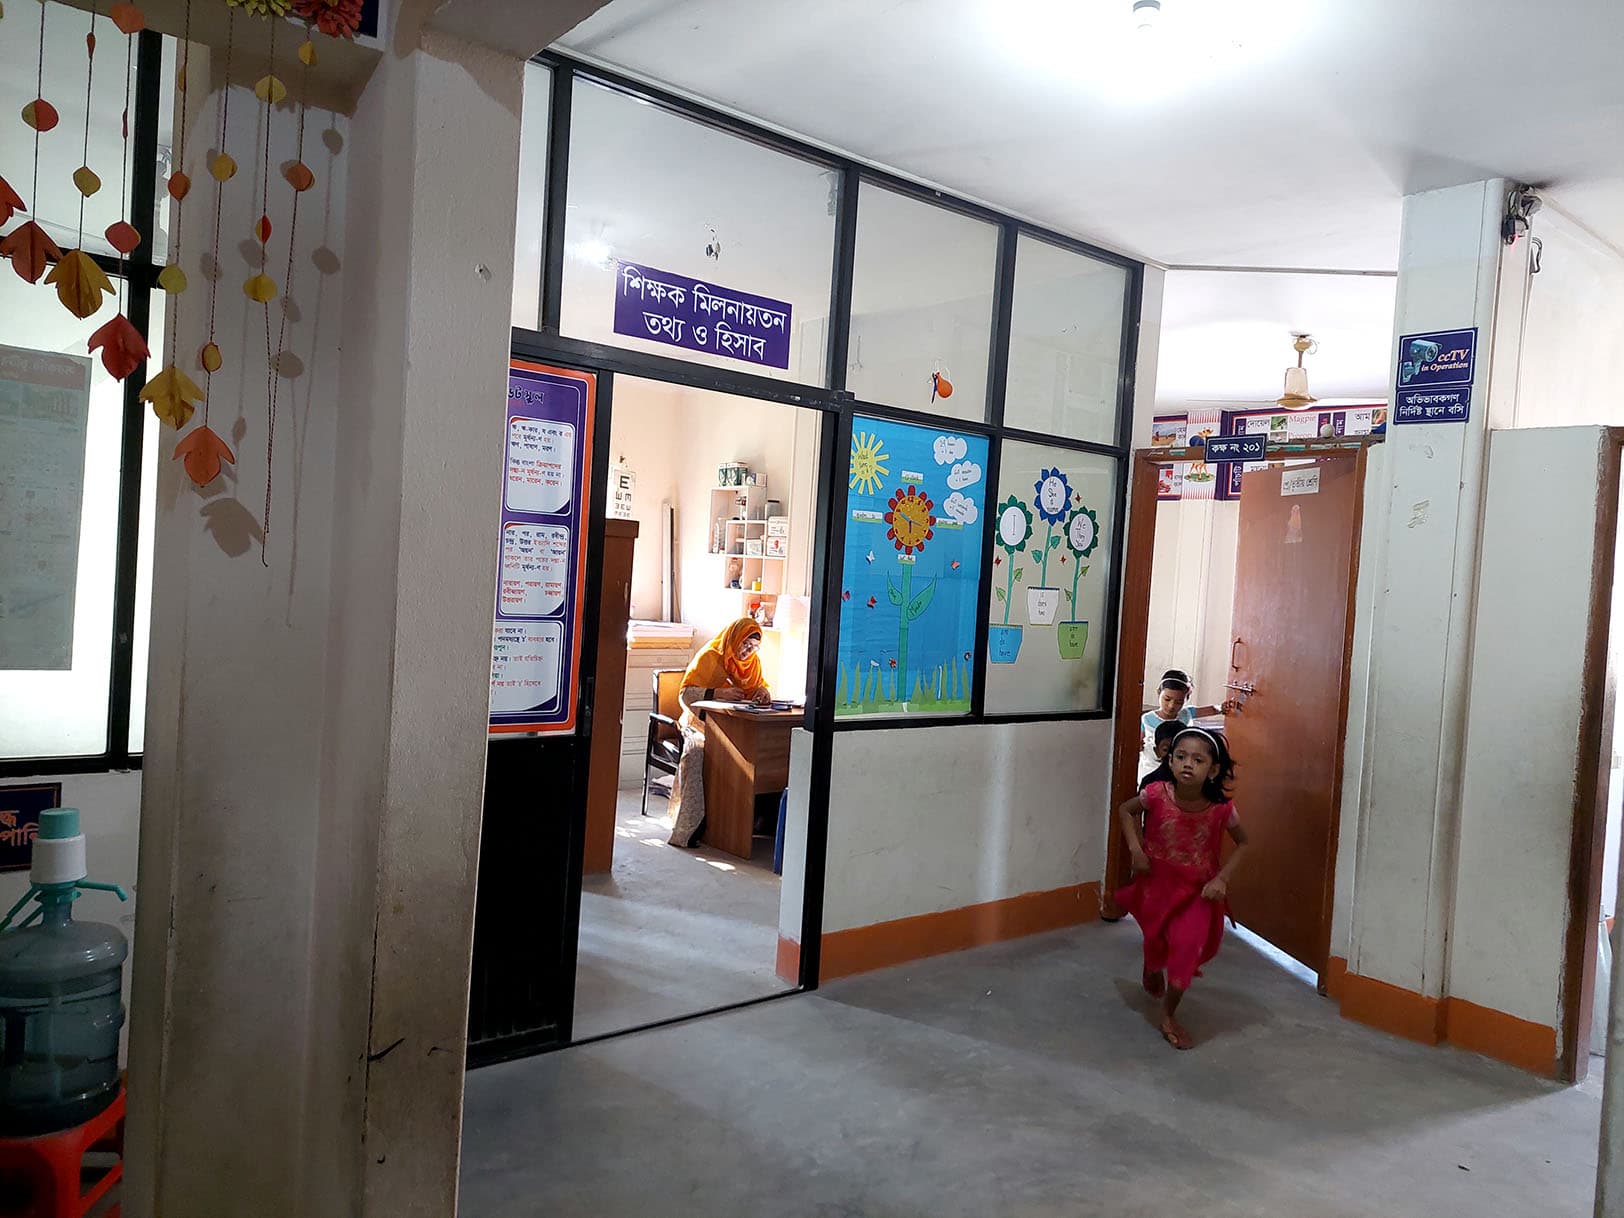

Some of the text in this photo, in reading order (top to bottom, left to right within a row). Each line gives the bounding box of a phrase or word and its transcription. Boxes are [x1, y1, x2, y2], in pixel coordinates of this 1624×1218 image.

[622, 265, 788, 334] শিক্ষক মিলনায়তন
[642, 311, 766, 360] তথ্য ও হিসাব
[1421, 361, 1469, 373] in Operation
[1406, 393, 1460, 405] অভিভাবকগণ
[1288, 415, 1317, 424] Magpie
[1210, 442, 1260, 453] কক্ষ নং ২০১
